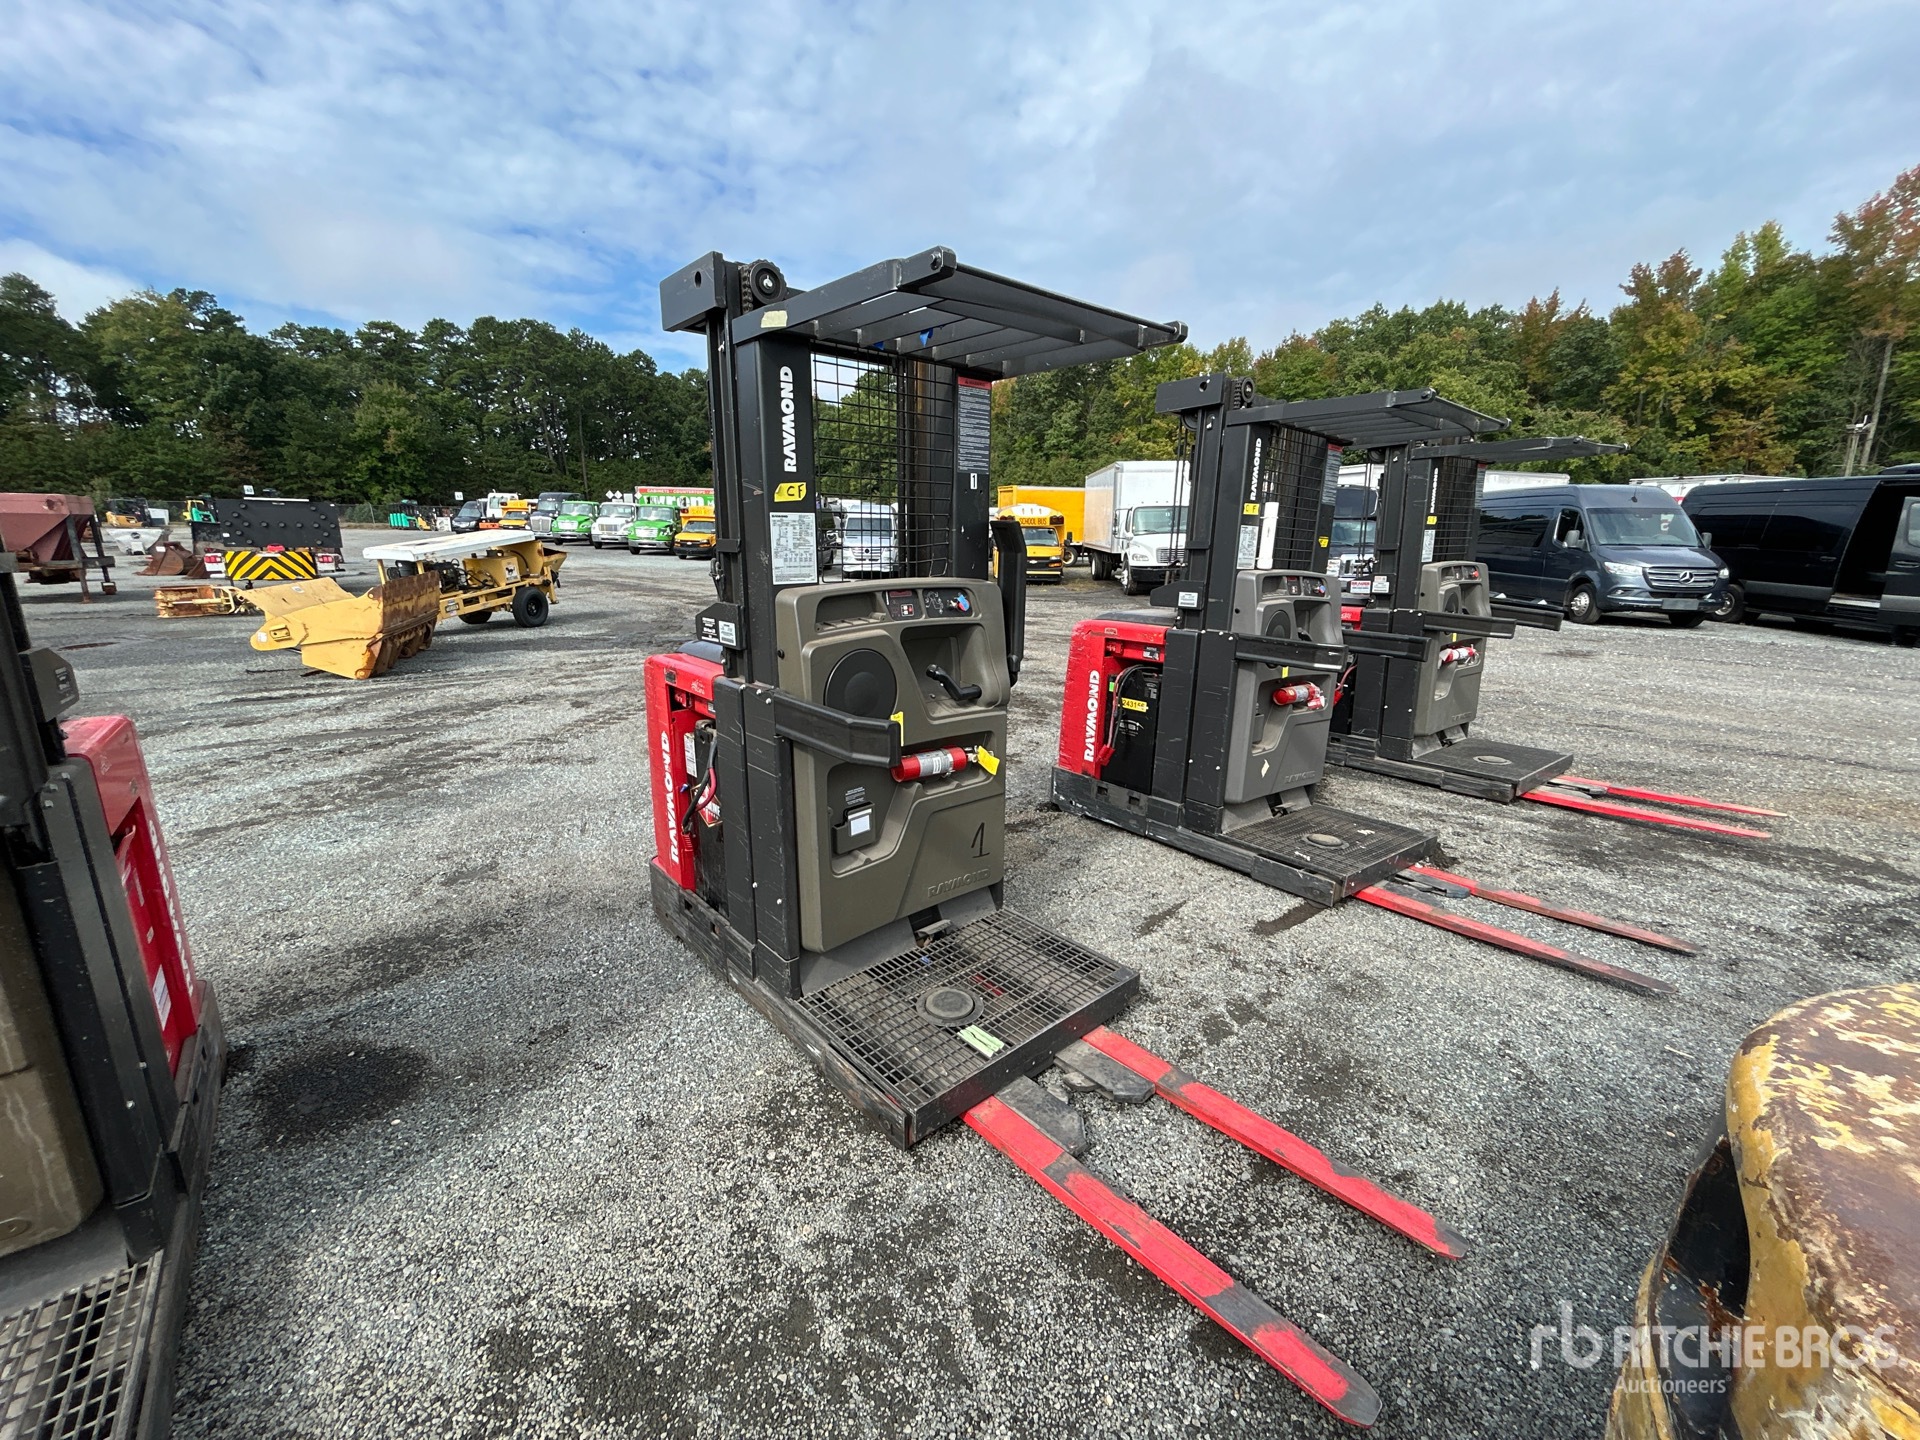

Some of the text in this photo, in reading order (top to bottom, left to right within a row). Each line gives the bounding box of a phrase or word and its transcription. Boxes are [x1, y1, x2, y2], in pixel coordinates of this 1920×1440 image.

[780, 366, 797, 473] RAYMOND
[1250, 437, 1262, 500] RAYMOND
[1084, 670, 1100, 762] RAYMOND
[661, 731, 679, 865] RAYMOND
[971, 822, 990, 858] 1
[927, 868, 991, 898] RAYMOND
